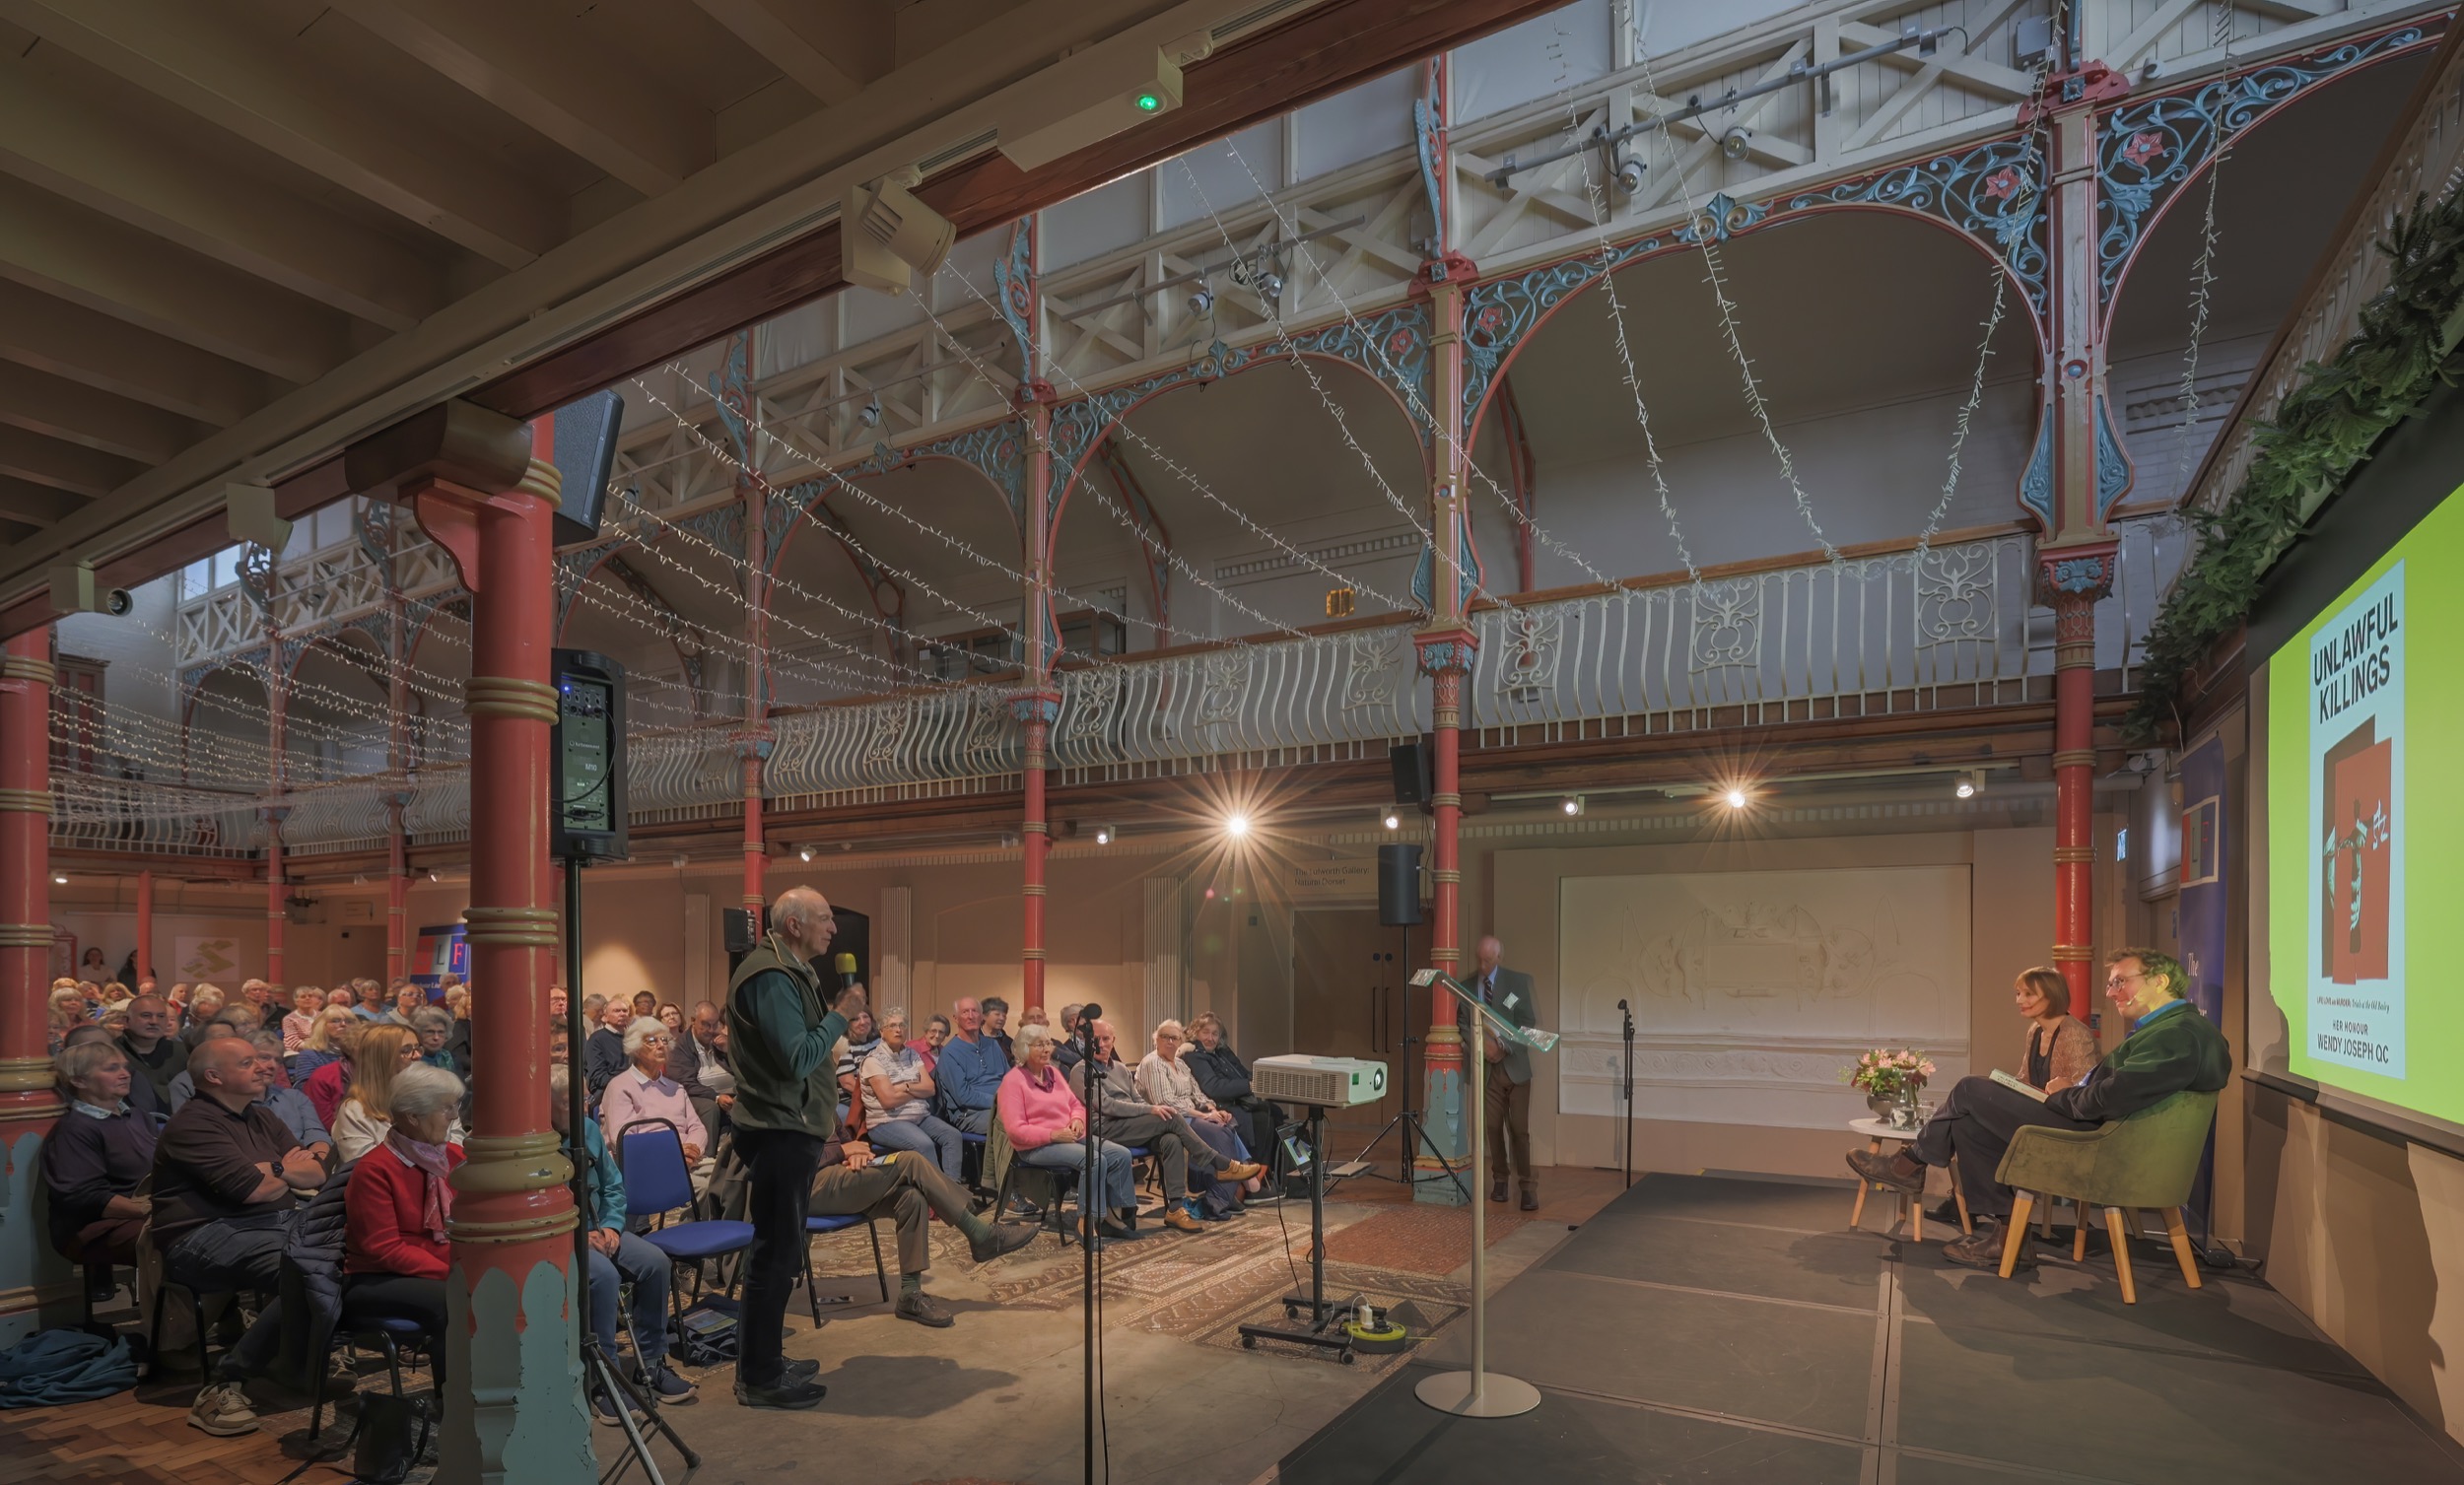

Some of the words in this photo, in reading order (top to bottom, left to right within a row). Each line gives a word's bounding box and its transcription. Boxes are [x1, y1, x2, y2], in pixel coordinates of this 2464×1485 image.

[2314, 591, 2398, 686] UNLAWFUL
[2319, 644, 2390, 724] KILLINGS
[1294, 878, 1321, 887] Natural
[1322, 877, 1346, 886] Dorset
[2187, 952, 2199, 978] The
[2332, 1019, 2343, 1032] HER
[2344, 1021, 2368, 1036] HONOUR
[2317, 1033, 2342, 1053] WENDY
[2343, 1038, 2373, 1060] JOSEPH
[2375, 1044, 2389, 1063] QC
